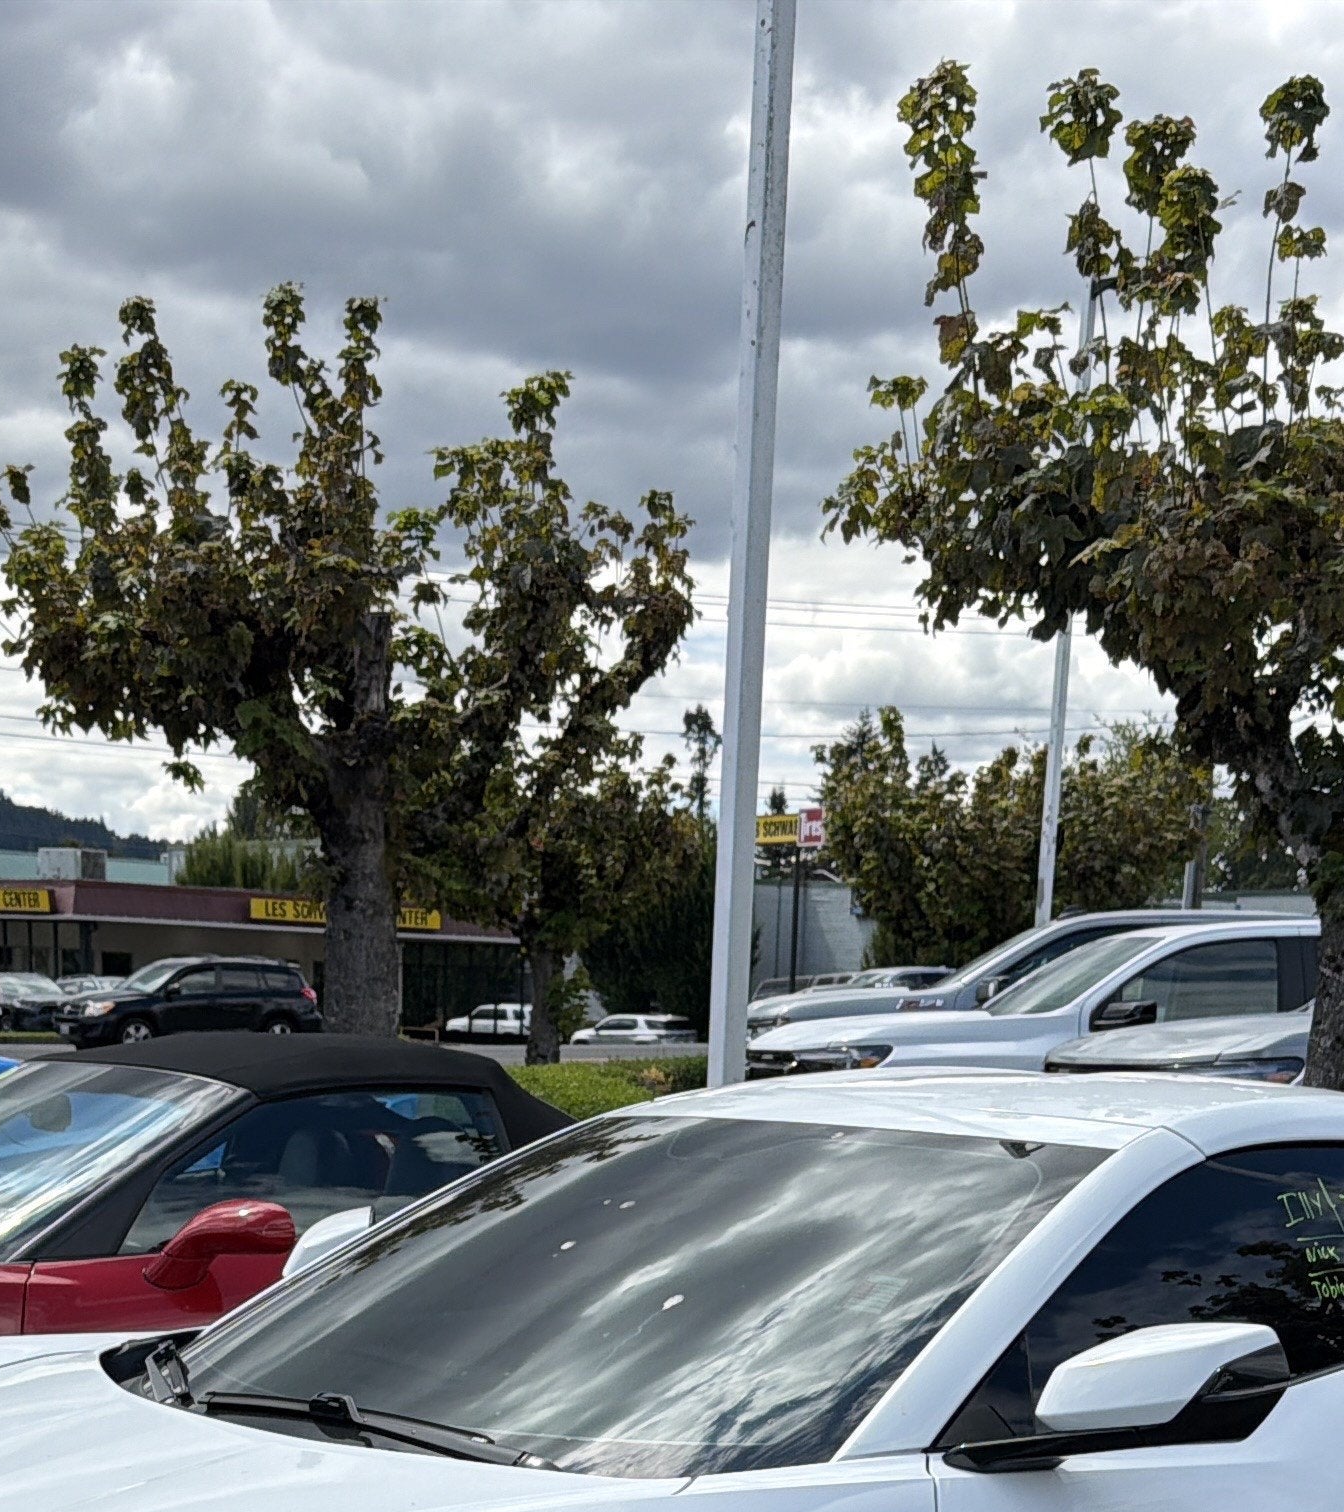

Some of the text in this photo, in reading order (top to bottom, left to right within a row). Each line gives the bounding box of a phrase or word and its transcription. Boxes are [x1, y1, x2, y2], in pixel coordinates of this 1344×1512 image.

[2, 891, 40, 909] CENTER
[264, 900, 287, 918] LES
[398, 909, 428, 927] NTER
